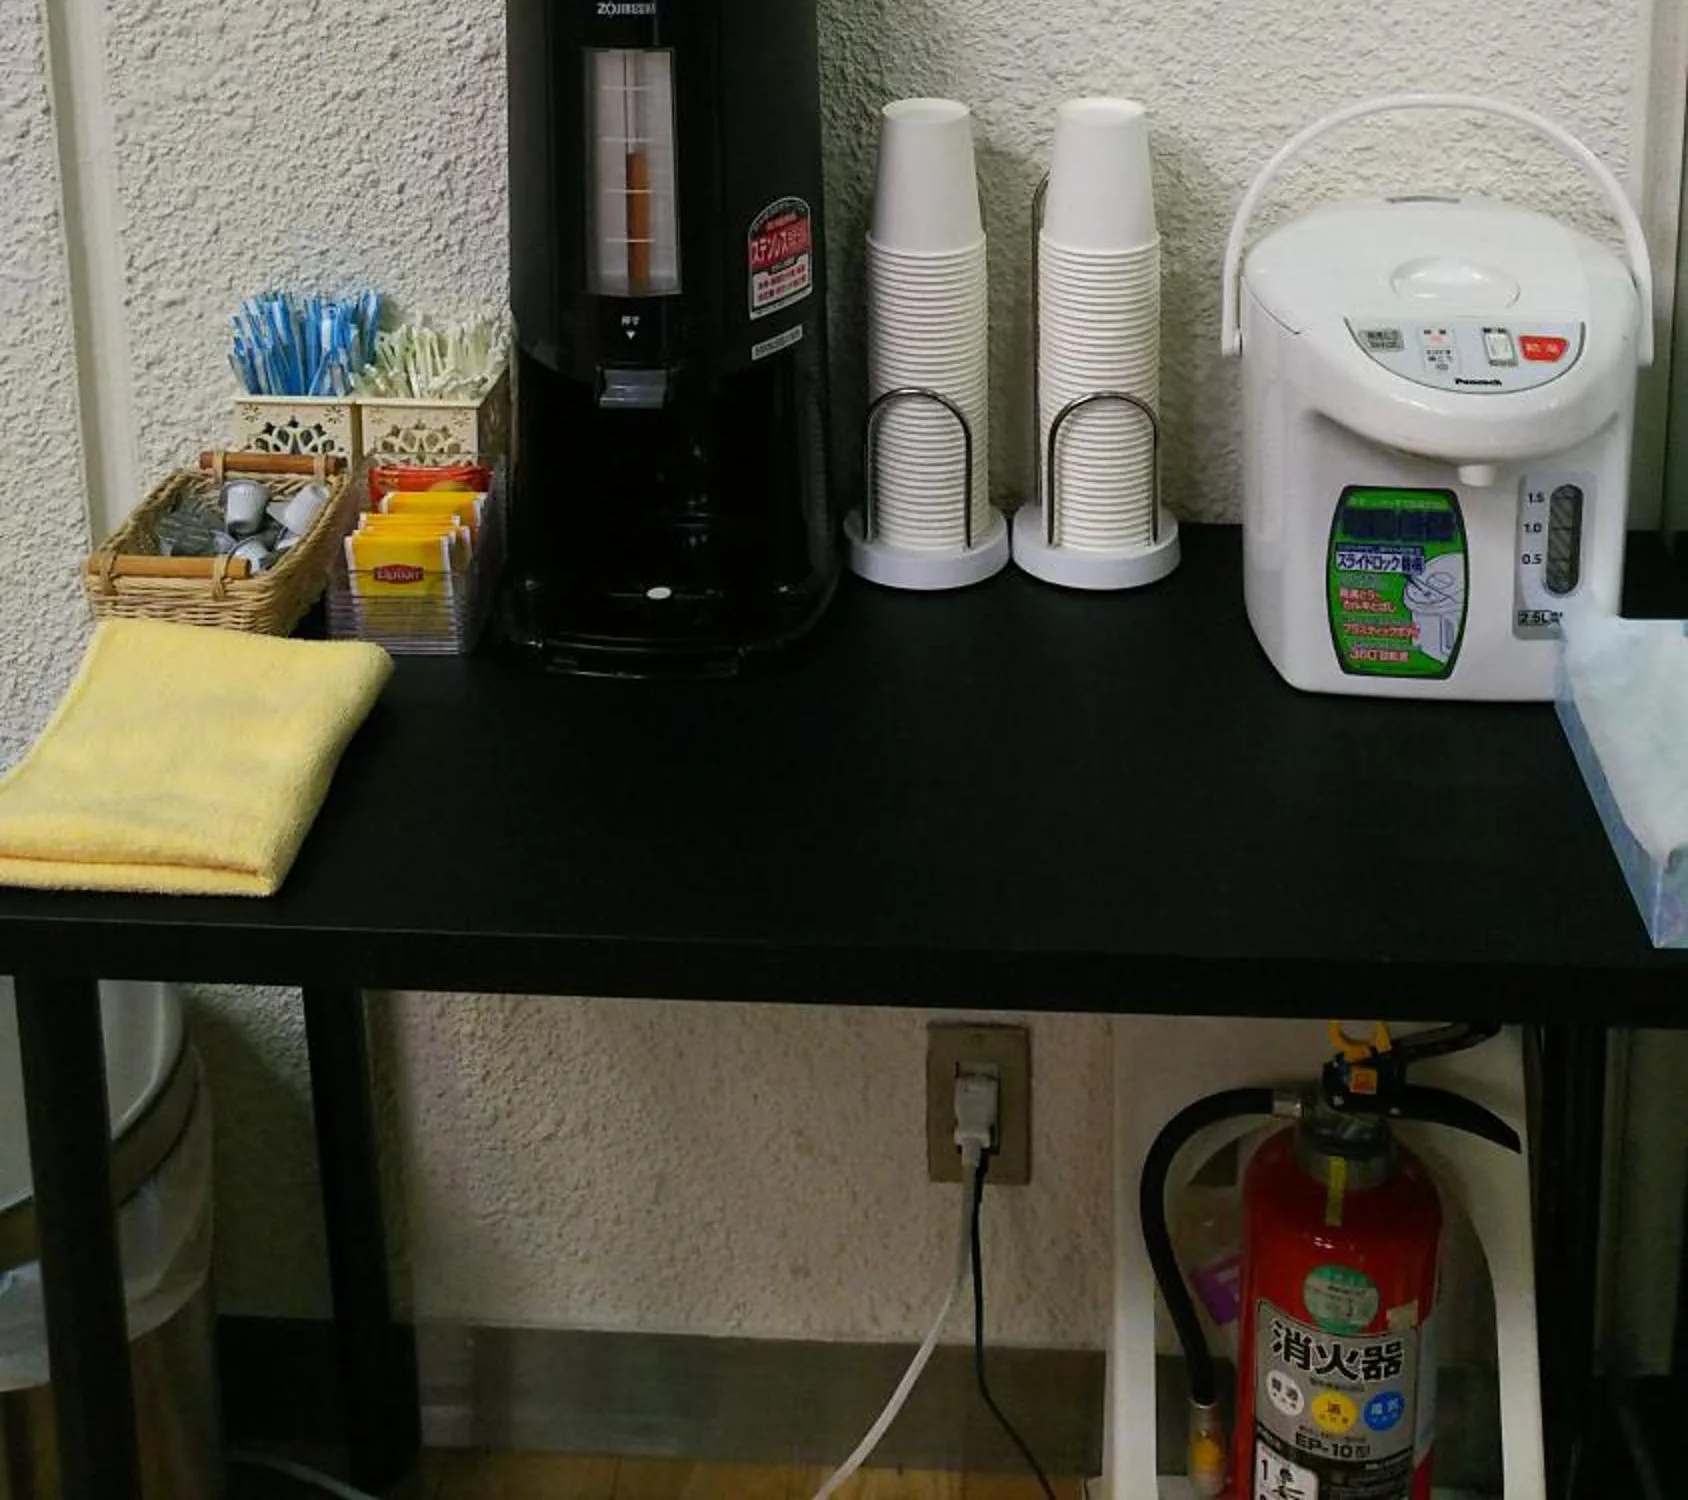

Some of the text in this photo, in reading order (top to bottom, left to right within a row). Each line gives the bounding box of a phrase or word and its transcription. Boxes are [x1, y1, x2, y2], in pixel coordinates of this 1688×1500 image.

[1523, 523, 1543, 533] 1.0
[1521, 554, 1543, 565] 0.5
[1271, 1319, 1403, 1381] 消火器
